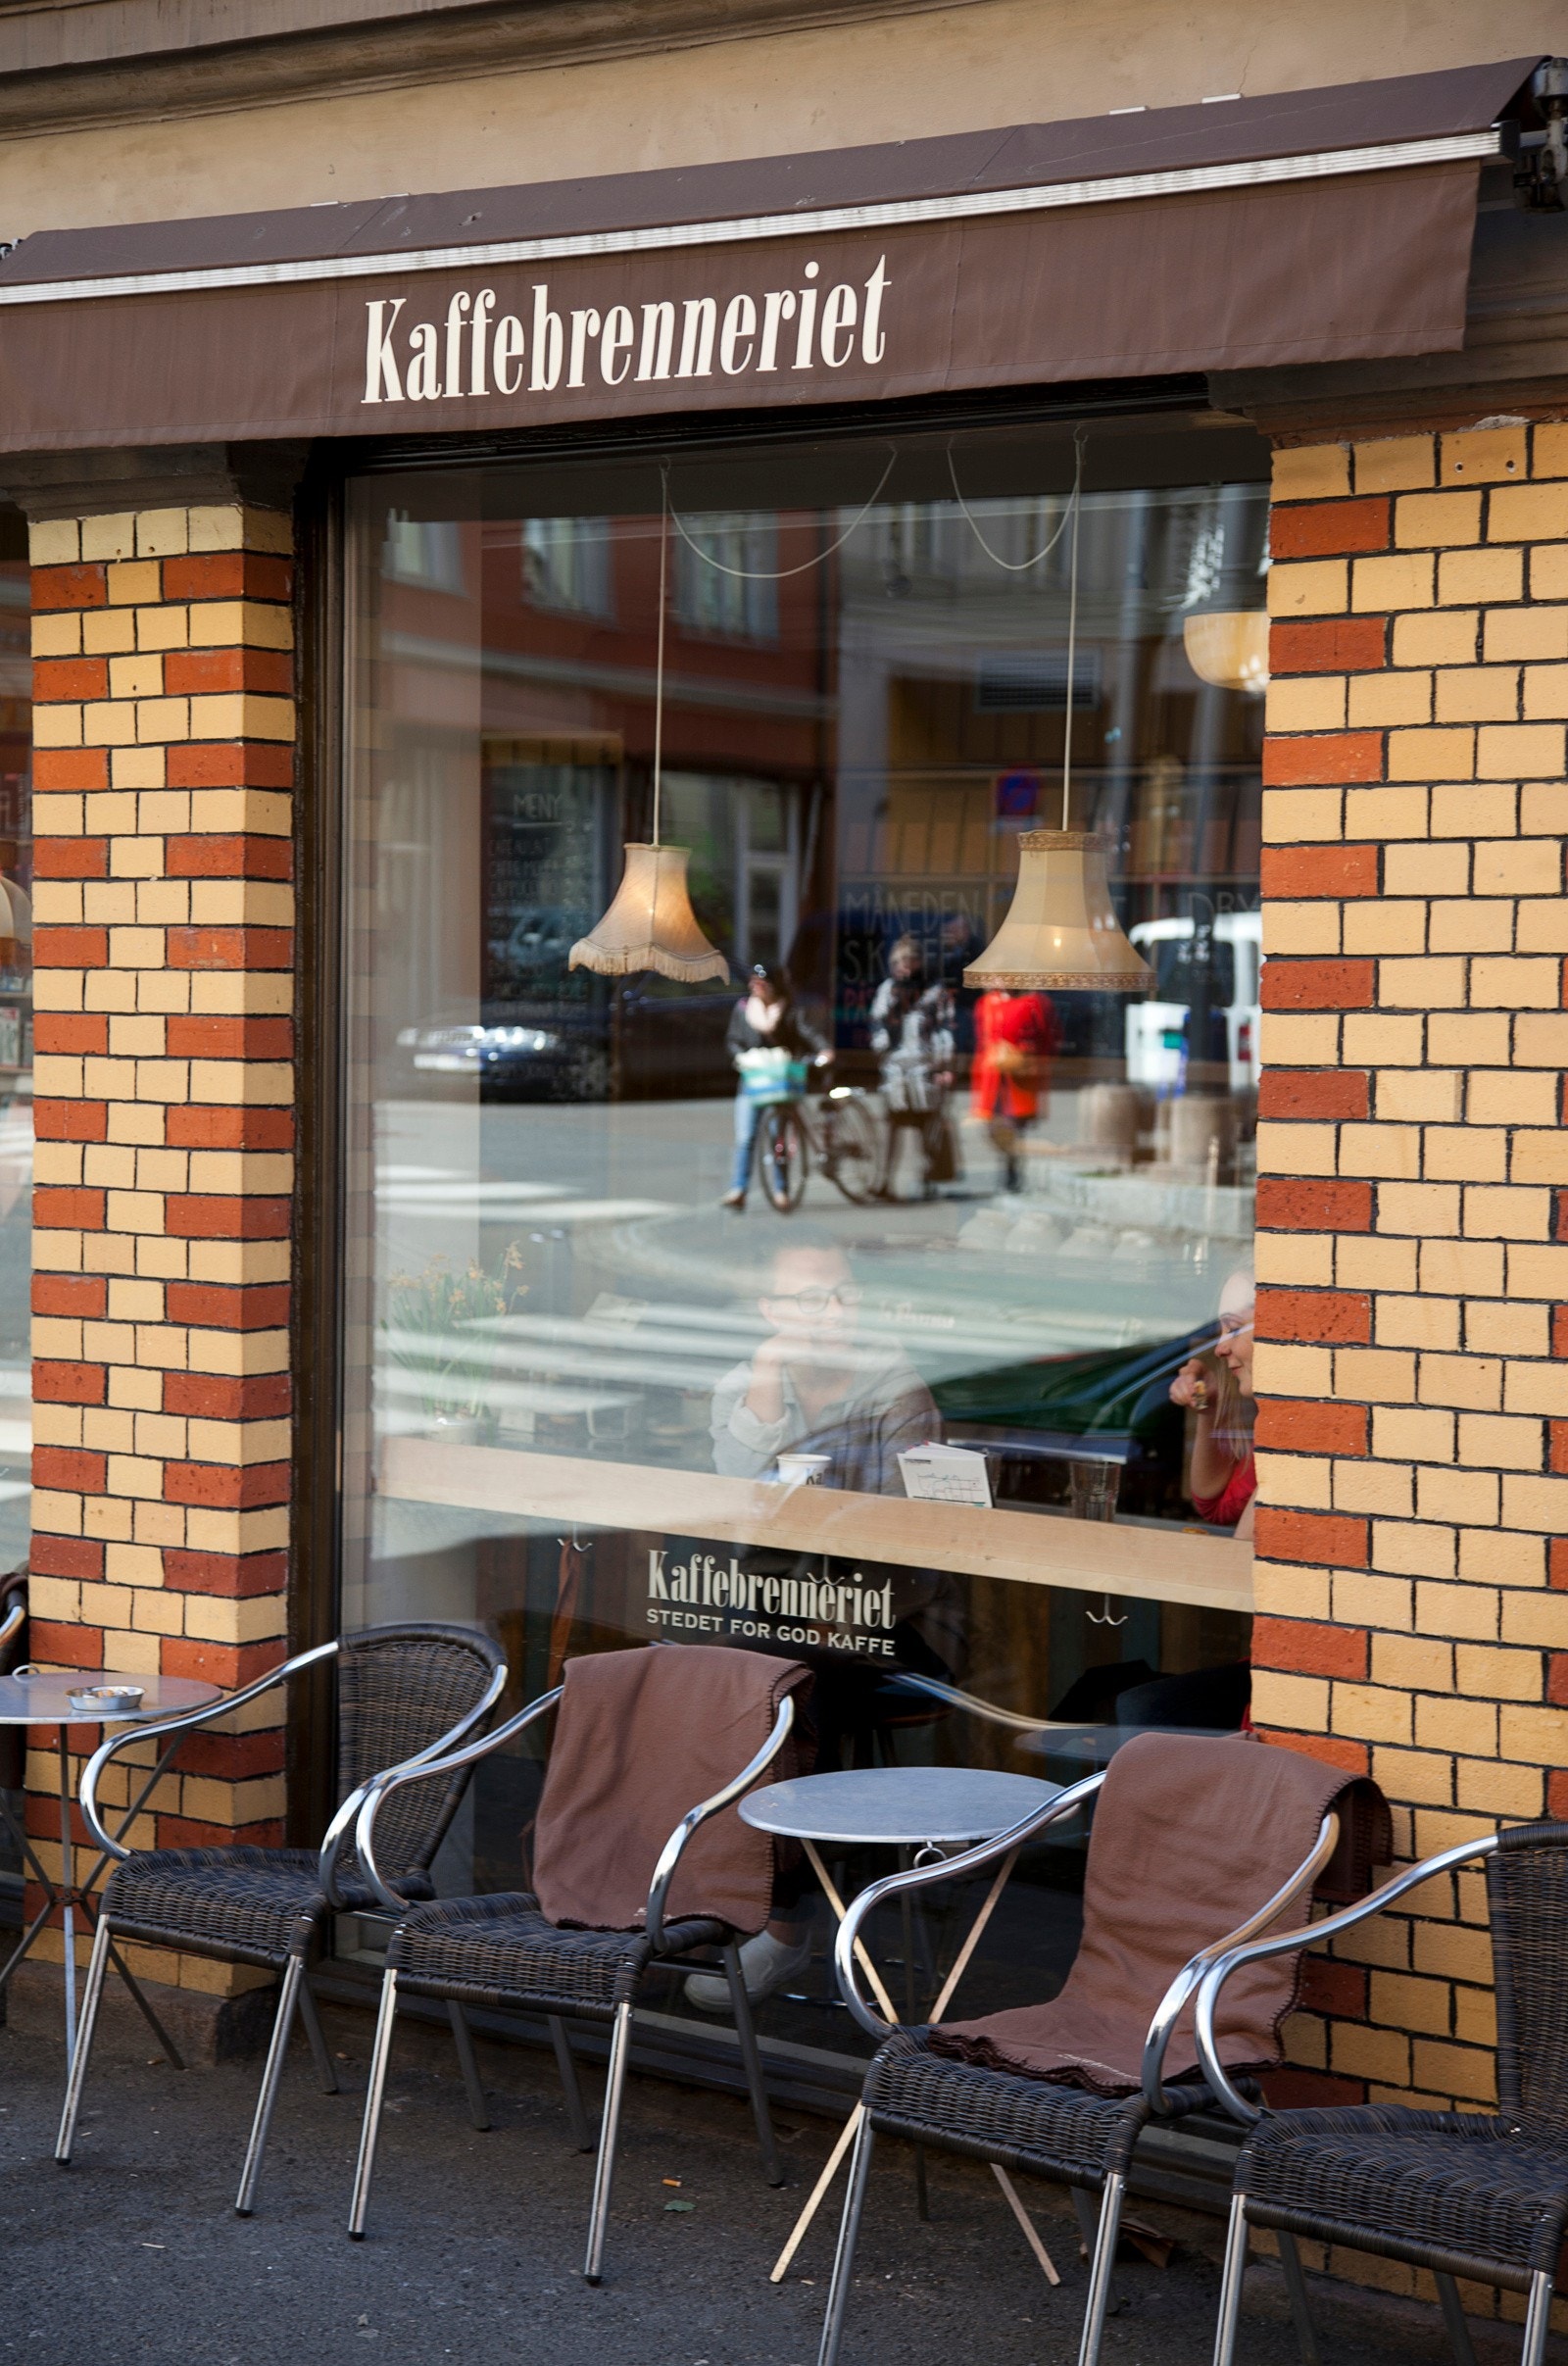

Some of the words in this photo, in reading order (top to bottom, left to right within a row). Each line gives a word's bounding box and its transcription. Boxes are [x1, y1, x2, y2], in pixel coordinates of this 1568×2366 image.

[361, 255, 892, 404] Kaffebrenneriet
[647, 1550, 896, 1629] Kaffebrenneriet
[647, 1608, 723, 1632] STEDET
[730, 1619, 770, 1639] FOR
[776, 1625, 820, 1646] GOD
[827, 1632, 896, 1656] KAFFE
